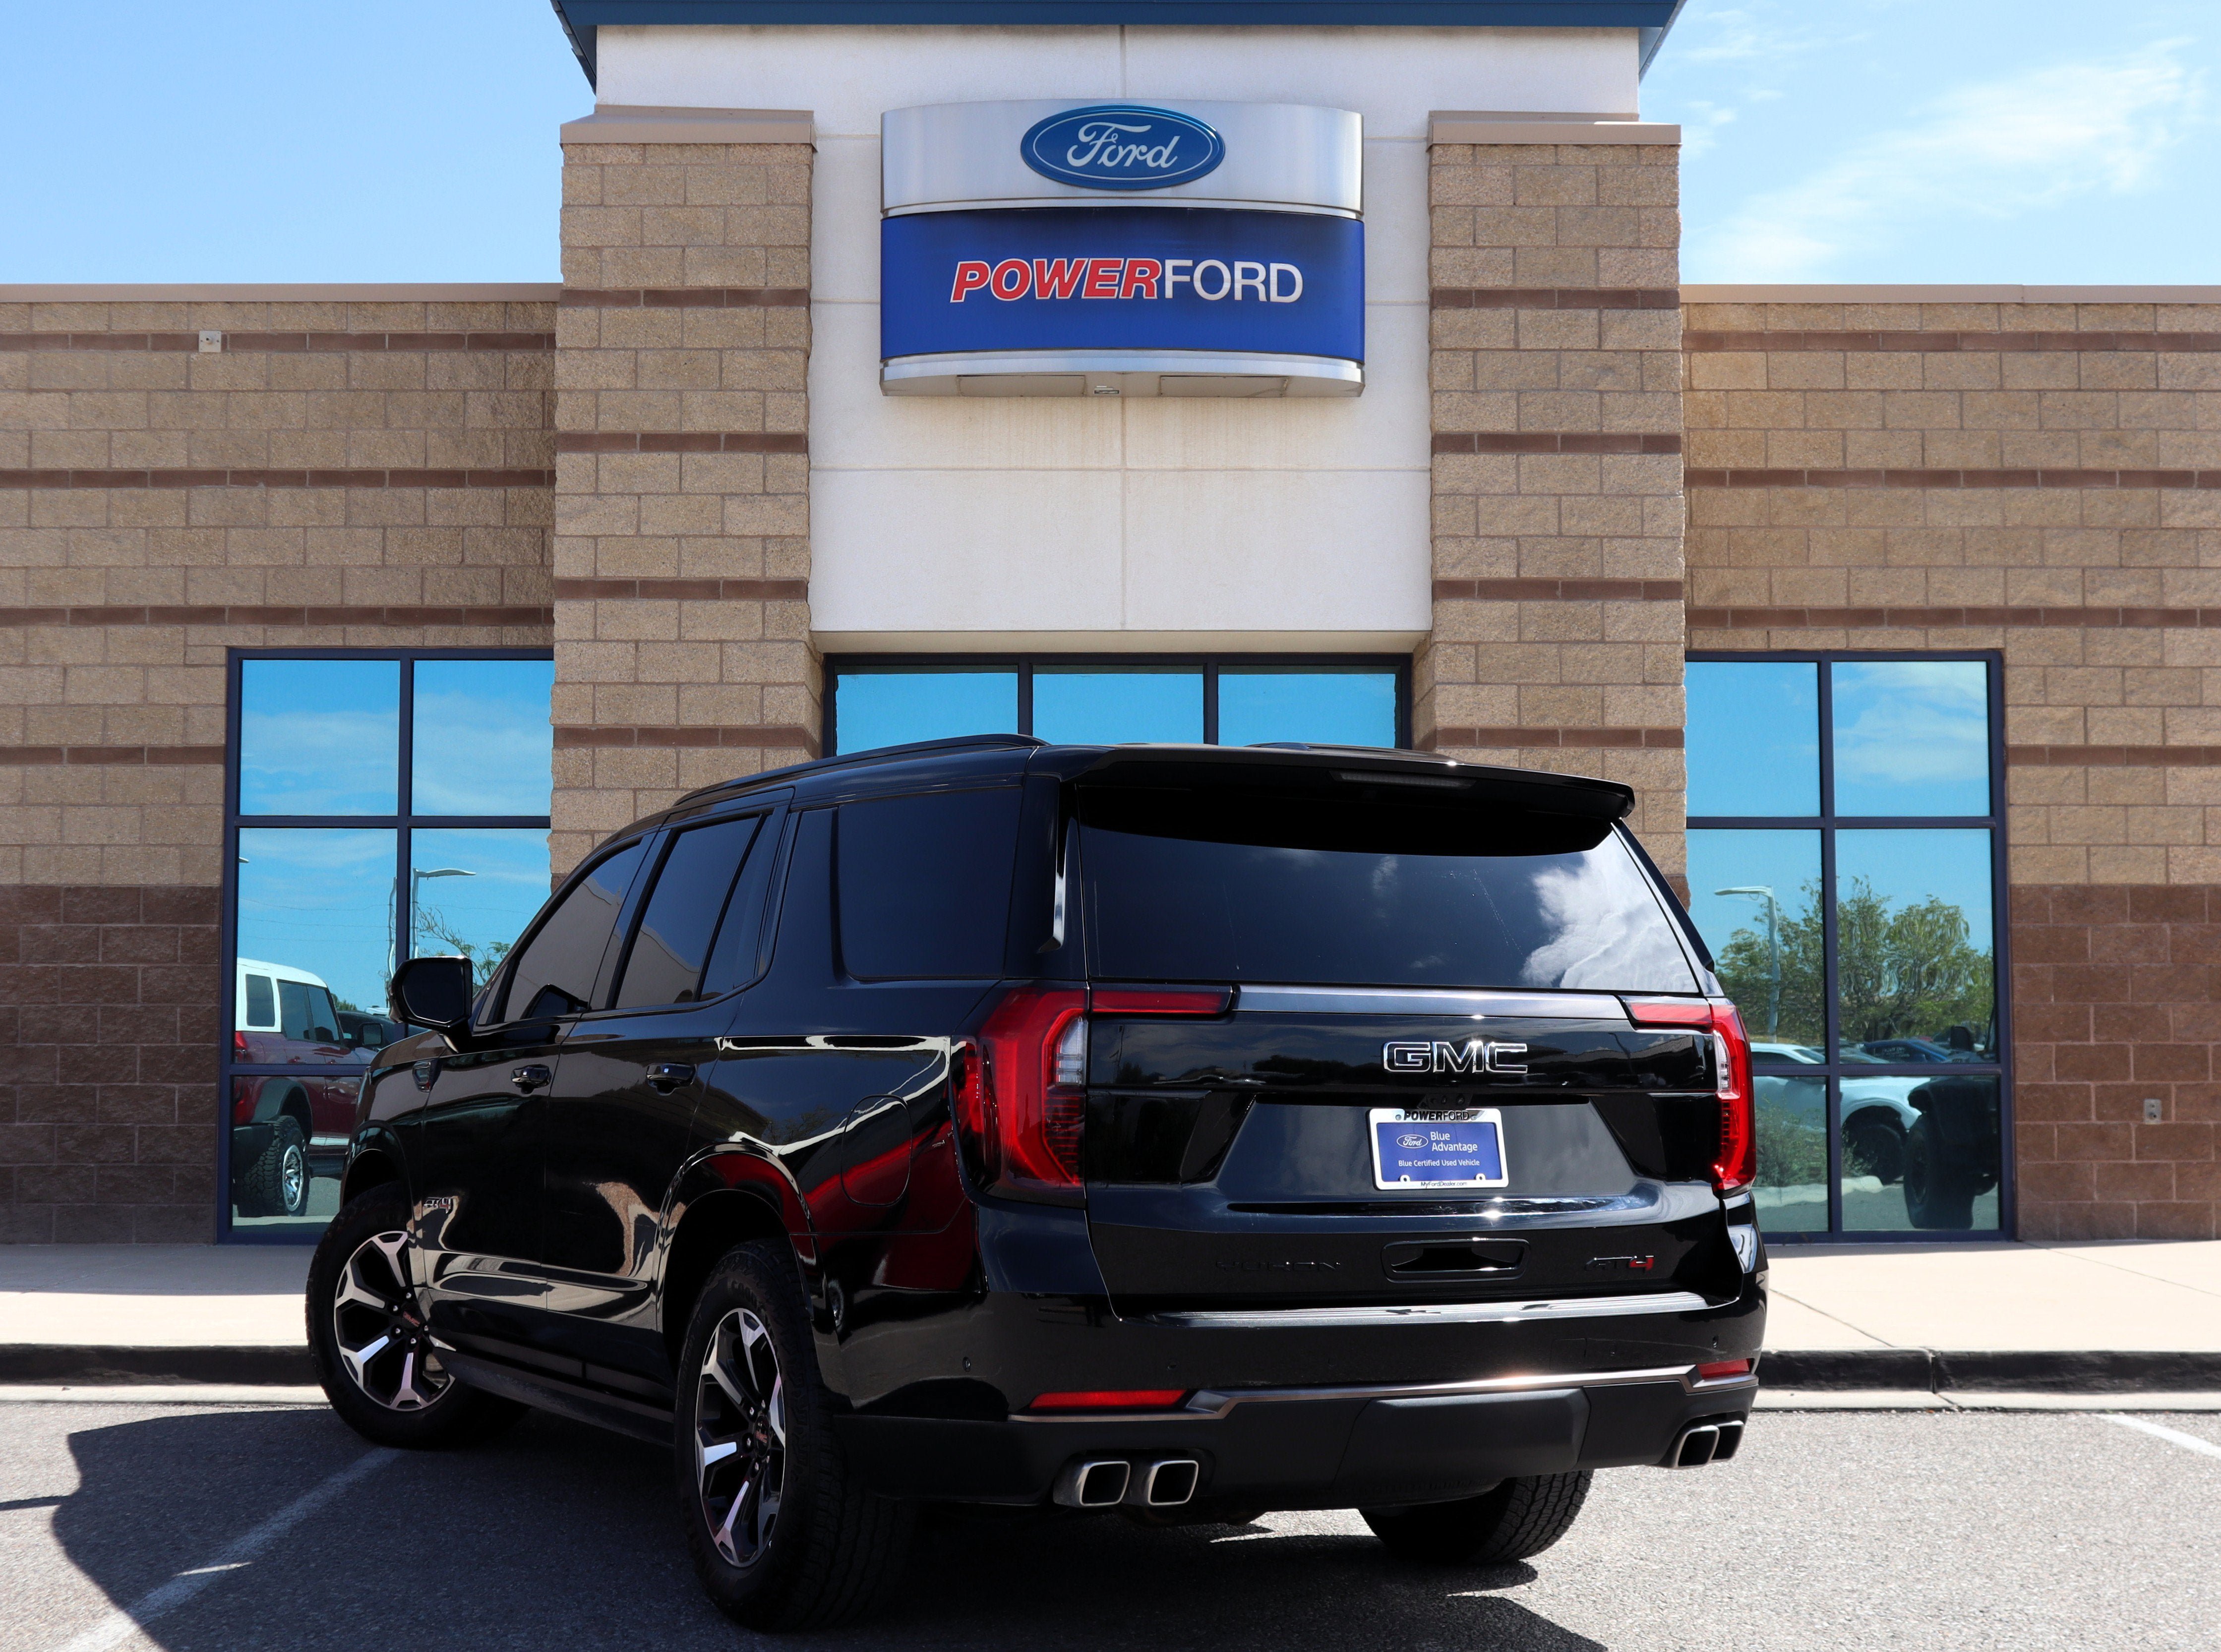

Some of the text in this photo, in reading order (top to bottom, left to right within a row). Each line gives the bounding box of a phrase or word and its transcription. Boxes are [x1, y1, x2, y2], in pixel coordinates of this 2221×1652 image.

[1066, 121, 1180, 169] Ford
[950, 257, 1303, 303] POWERFORD
[1382, 1041, 1528, 1074] GMC
[1403, 1110, 1469, 1121] POWERFORD
[1402, 1135, 1423, 1147] Ford
[1430, 1131, 1450, 1141] Blue
[1432, 1142, 1478, 1153] Advantage
